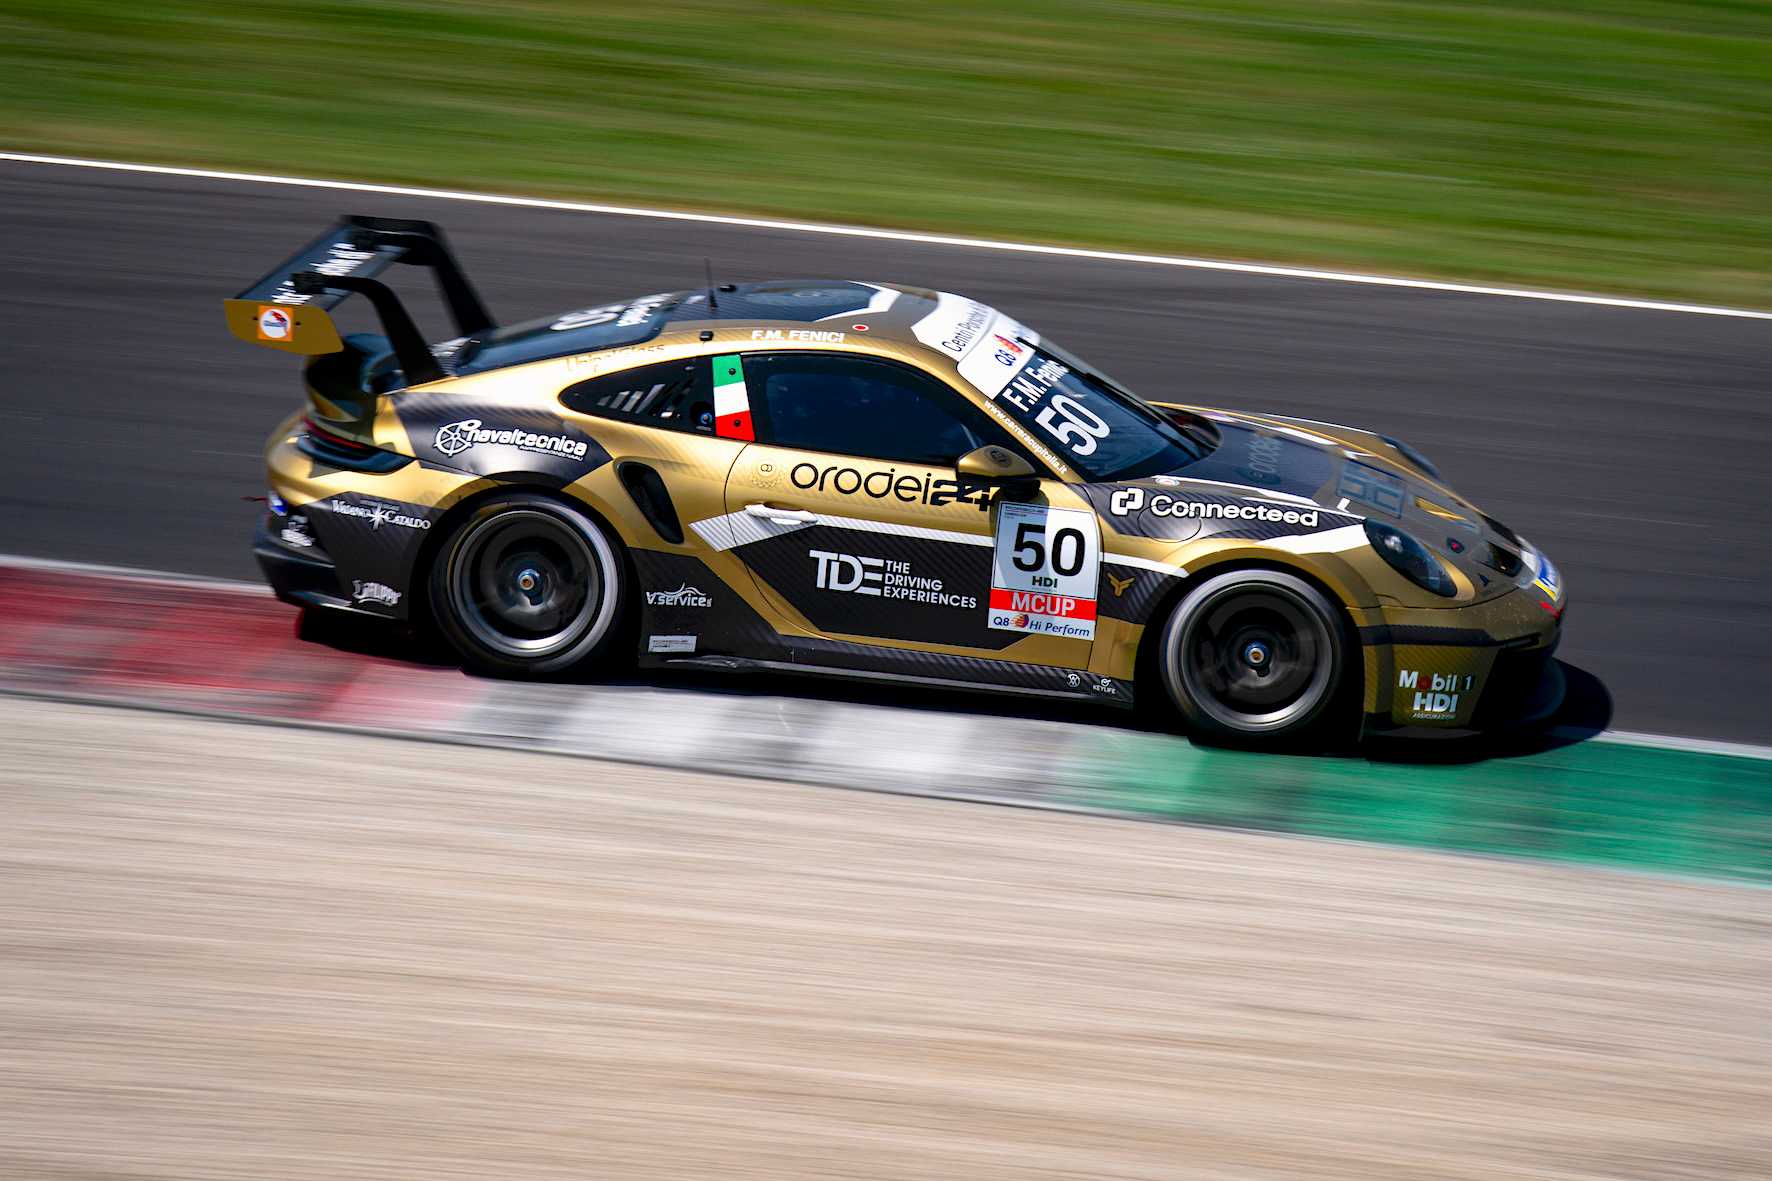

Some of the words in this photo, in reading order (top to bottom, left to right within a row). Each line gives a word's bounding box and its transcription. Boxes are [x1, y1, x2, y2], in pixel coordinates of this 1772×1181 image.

[789, 330, 845, 343] FENICI
[994, 349, 1017, 367] Q8
[1035, 394, 1111, 456] 50
[467, 428, 588, 457] navaltecnica
[984, 400, 1069, 475] www.carreracupitalia.it
[1150, 495, 1319, 527] Connecteed
[1012, 523, 1085, 577] 50
[809, 549, 884, 597] TDE
[885, 560, 911, 574] THE
[884, 573, 943, 591] DRIVING
[1032, 575, 1058, 588] HDI
[883, 587, 977, 609] EXPERIENCES
[1011, 592, 1076, 617] MCUP
[993, 616, 1010, 627] Q8
[1029, 620, 1042, 631] Hi
[1045, 621, 1090, 637] Perform
[1398, 670, 1458, 692] Mobil
[1465, 675, 1472, 690] 1
[1412, 691, 1460, 713] HDI
